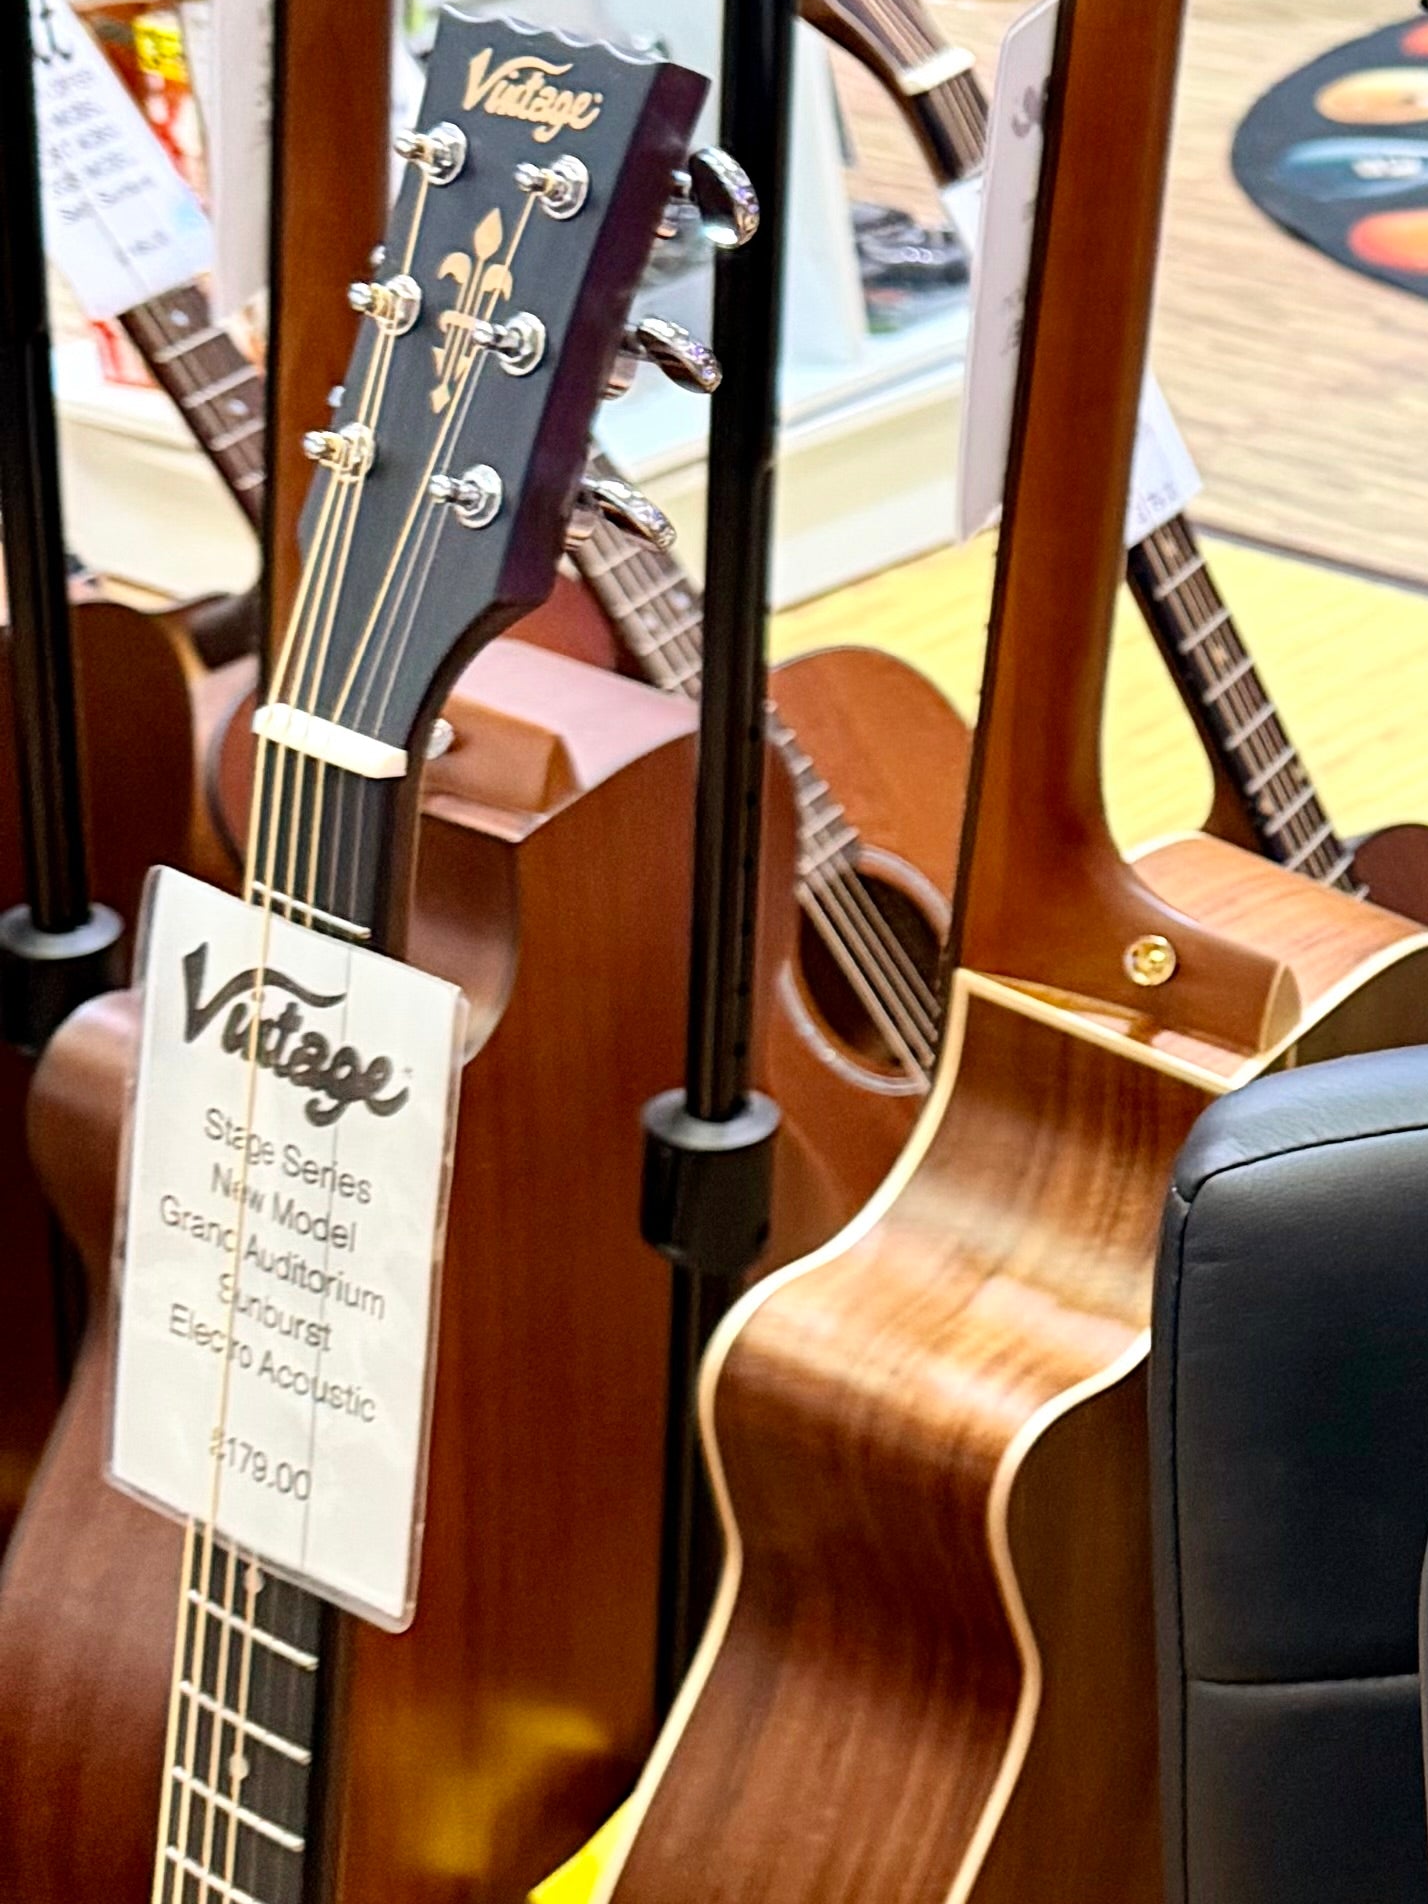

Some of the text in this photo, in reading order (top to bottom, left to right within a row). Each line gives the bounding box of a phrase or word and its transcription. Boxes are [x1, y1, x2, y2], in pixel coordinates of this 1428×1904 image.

[462, 47, 604, 144] Vintage
[182, 941, 410, 1128] Vintage
[204, 1107, 372, 1205] Stage Series
[211, 1162, 358, 1253] New Model
[217, 1273, 333, 1352] Sunburst
[243, 1233, 387, 1321] Auditorium
[169, 1302, 376, 1423] Elecro Acoustic
